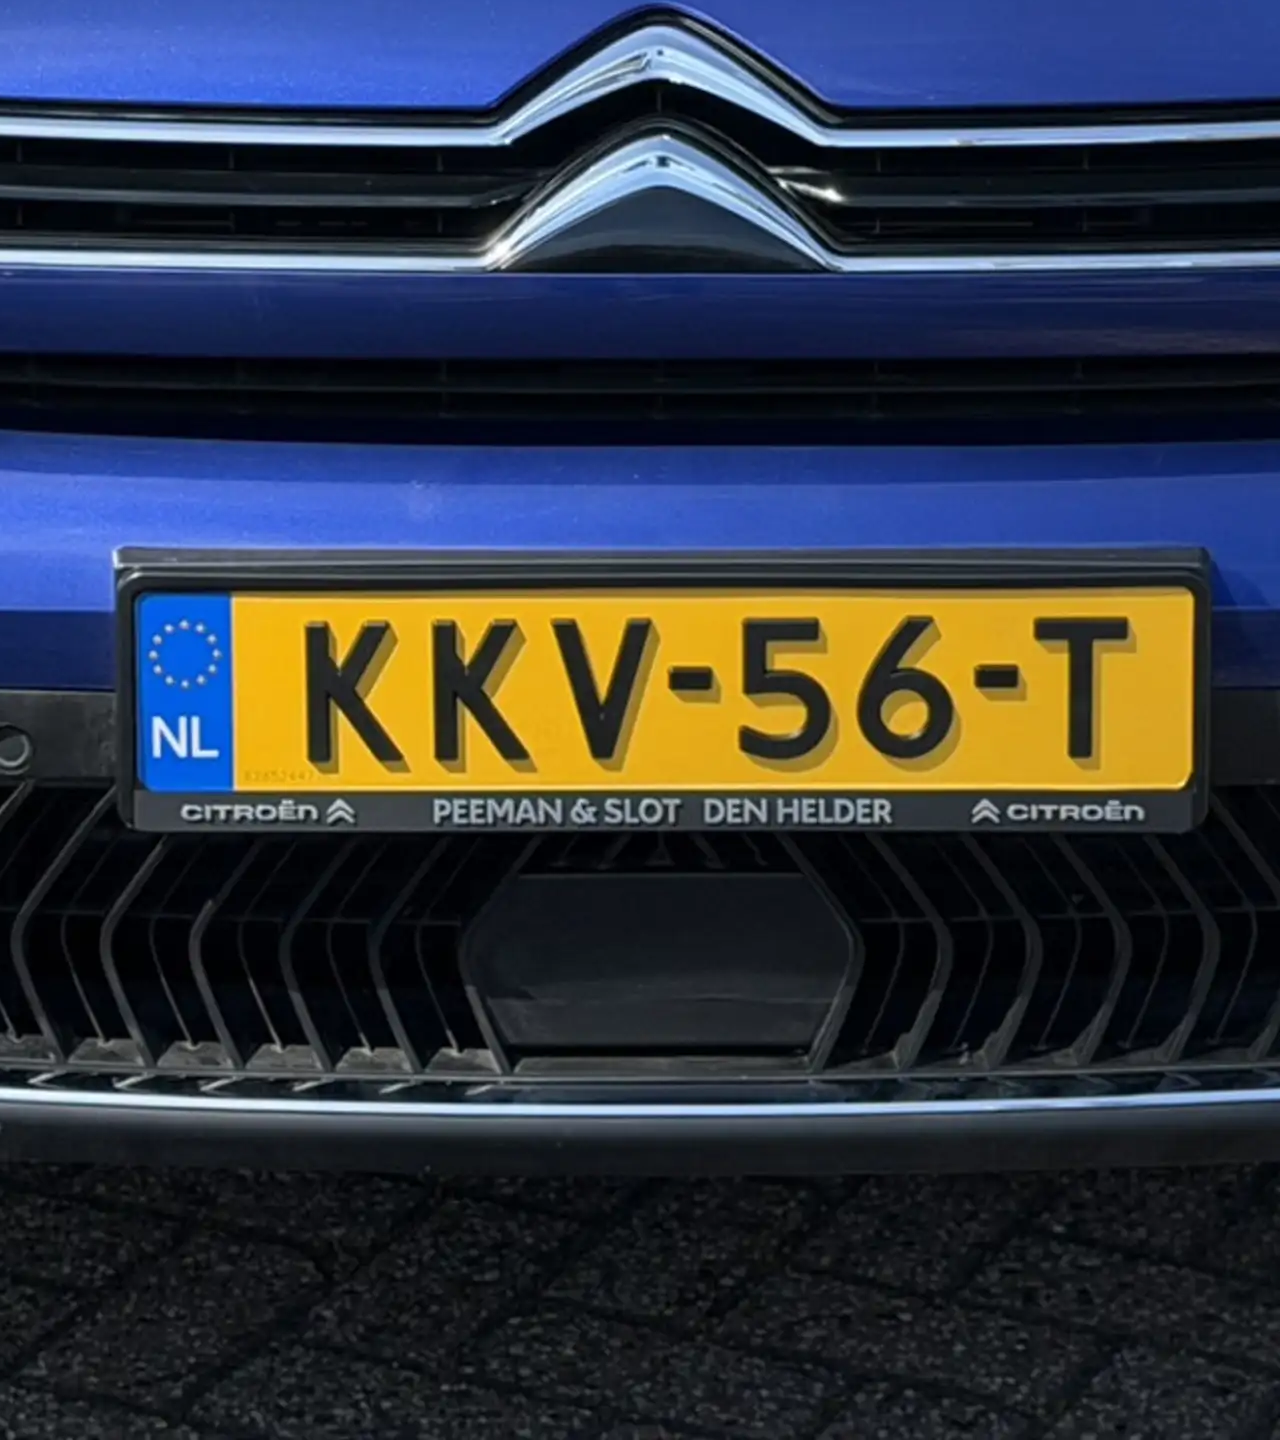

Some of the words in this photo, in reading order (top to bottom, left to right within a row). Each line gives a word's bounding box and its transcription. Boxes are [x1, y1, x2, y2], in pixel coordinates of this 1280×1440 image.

[304, 617, 1132, 765] KKV-56-T
[152, 716, 219, 759] NL
[433, 799, 562, 824] PEEMAN
[570, 798, 597, 824] &
[604, 798, 681, 824] SLOT
[704, 799, 767, 824] DEN
[777, 799, 892, 824] HELDER
